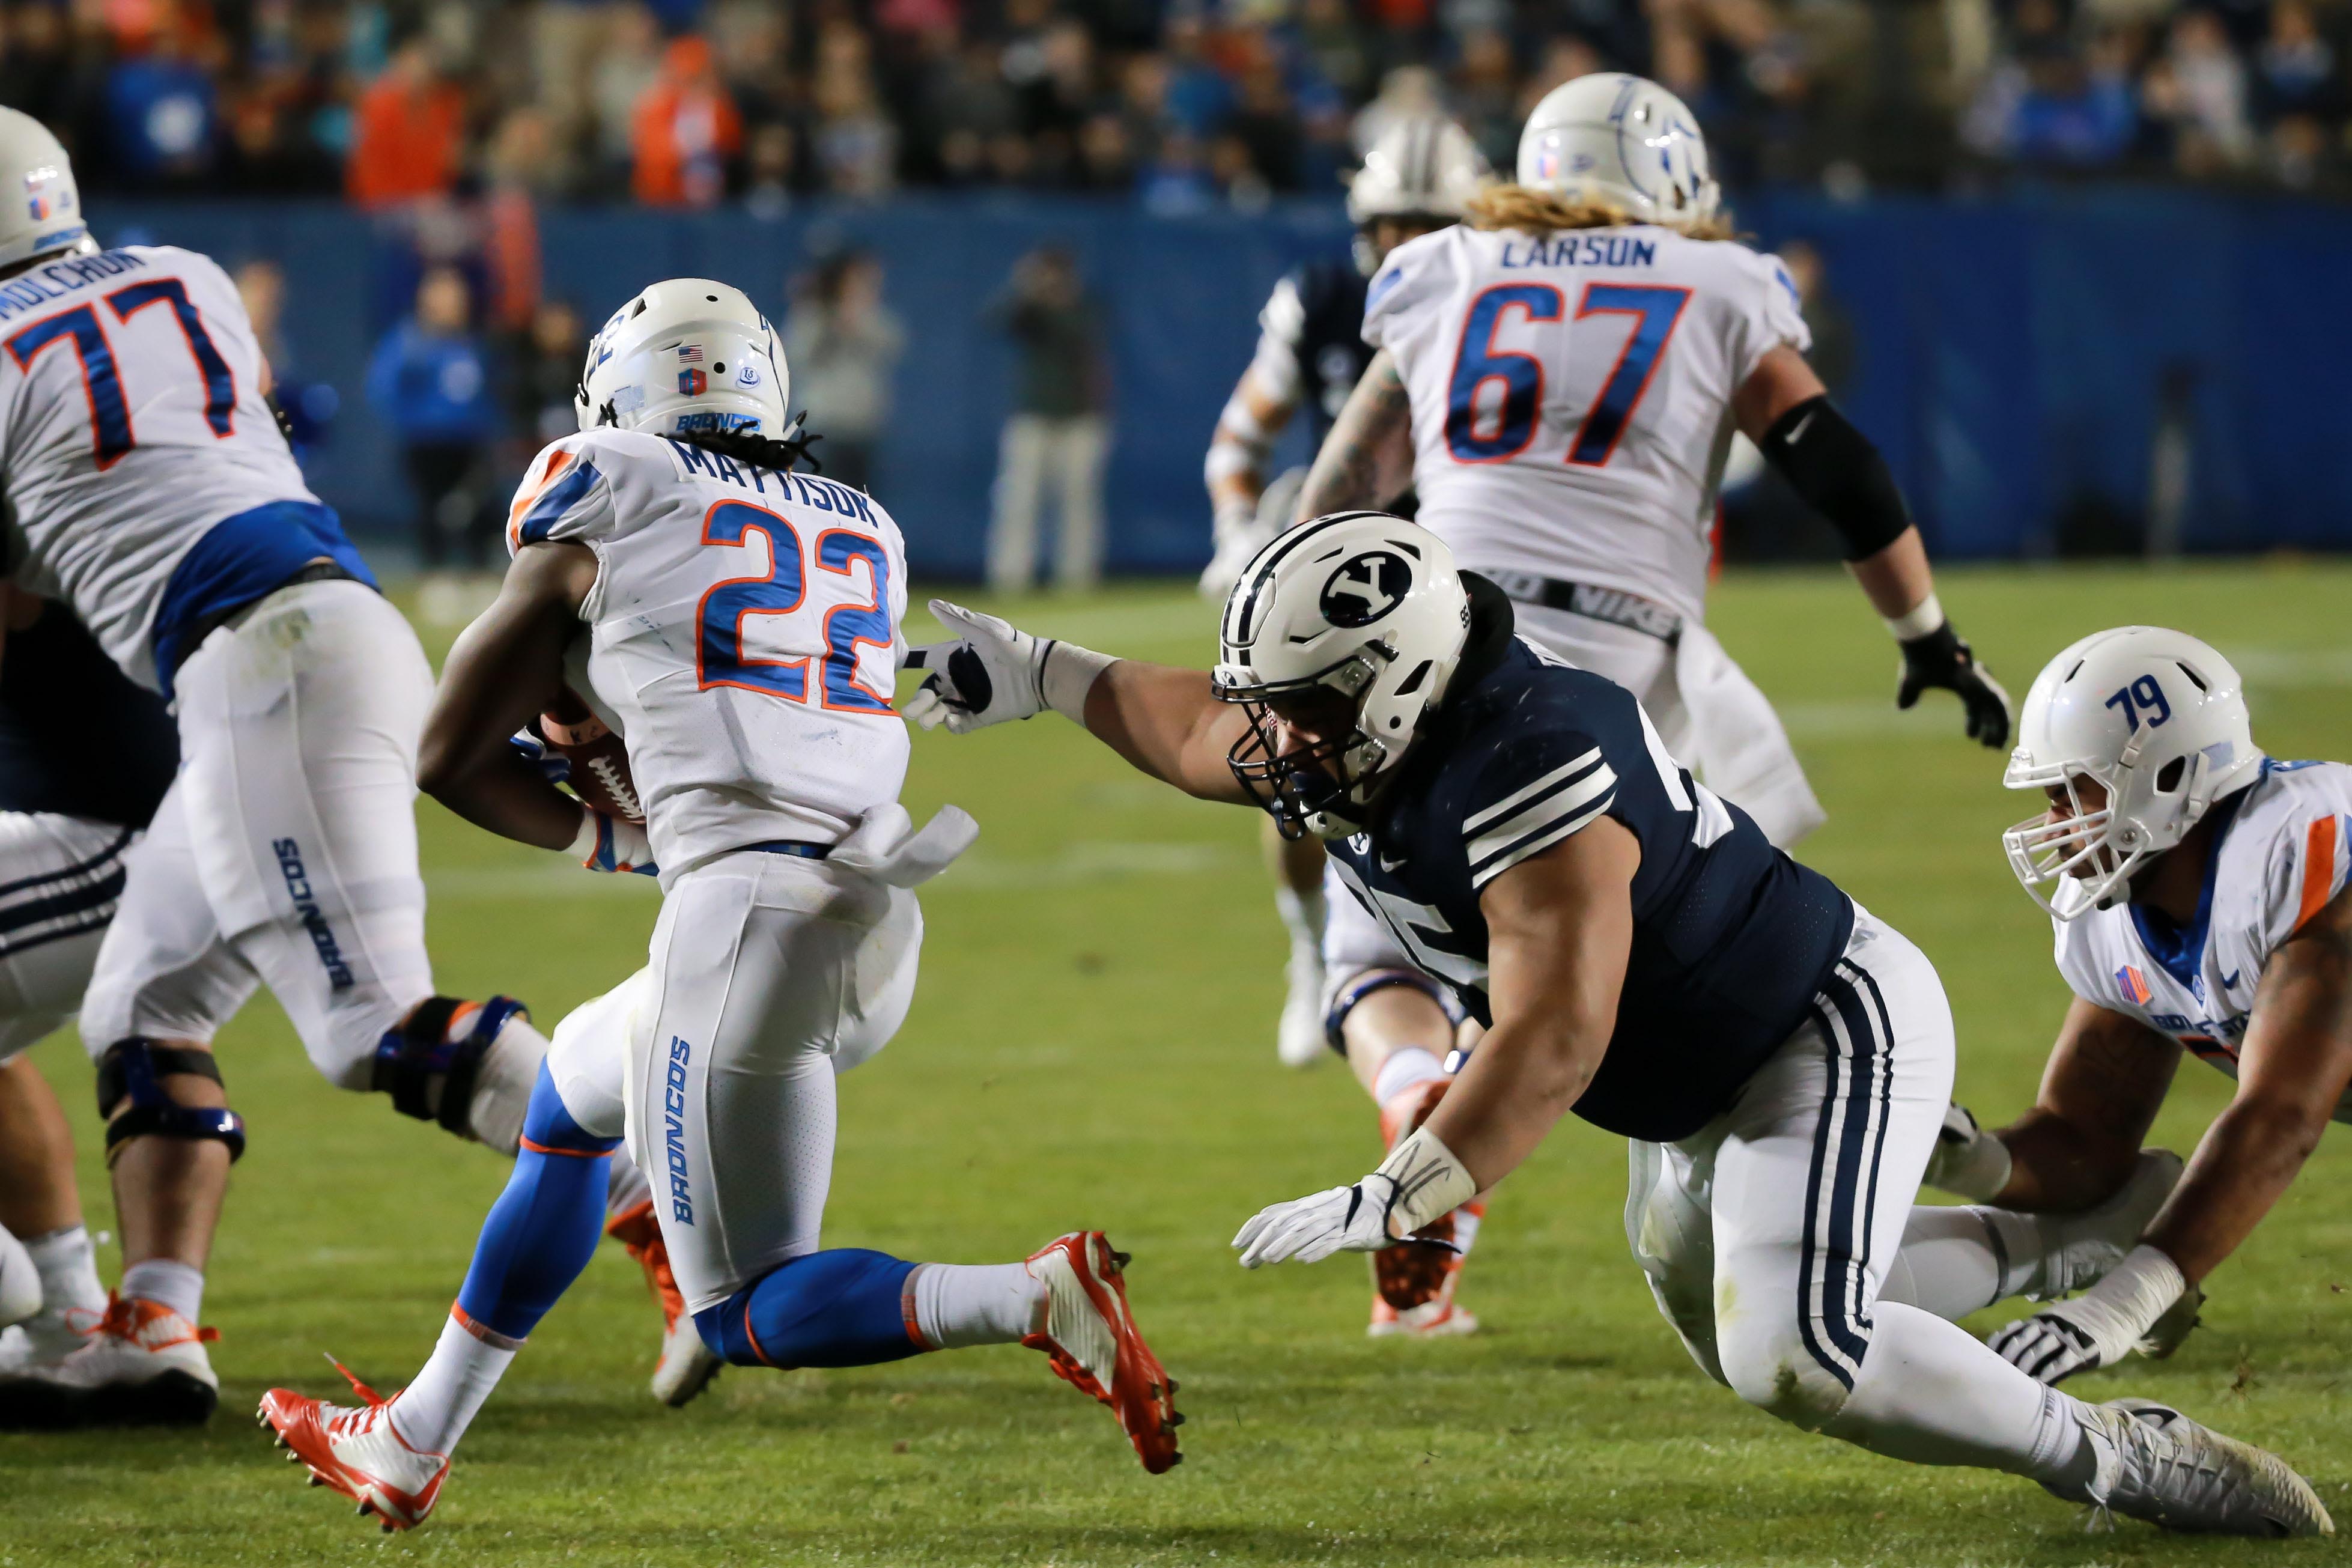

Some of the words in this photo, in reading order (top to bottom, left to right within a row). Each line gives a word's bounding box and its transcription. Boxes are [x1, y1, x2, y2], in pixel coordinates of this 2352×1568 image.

[1501, 236, 1655, 267] LARSON
[3, 277, 237, 472] 77
[676, 412, 762, 432] BRONCOS
[1444, 282, 1694, 467] 67
[669, 439, 879, 529] MATTISON
[696, 499, 903, 717] 22
[1326, 556, 1396, 617] Y
[2104, 673, 2171, 736] 79
[273, 837, 354, 991] BRONCOS
[664, 1035, 695, 1227] BRONCOS
